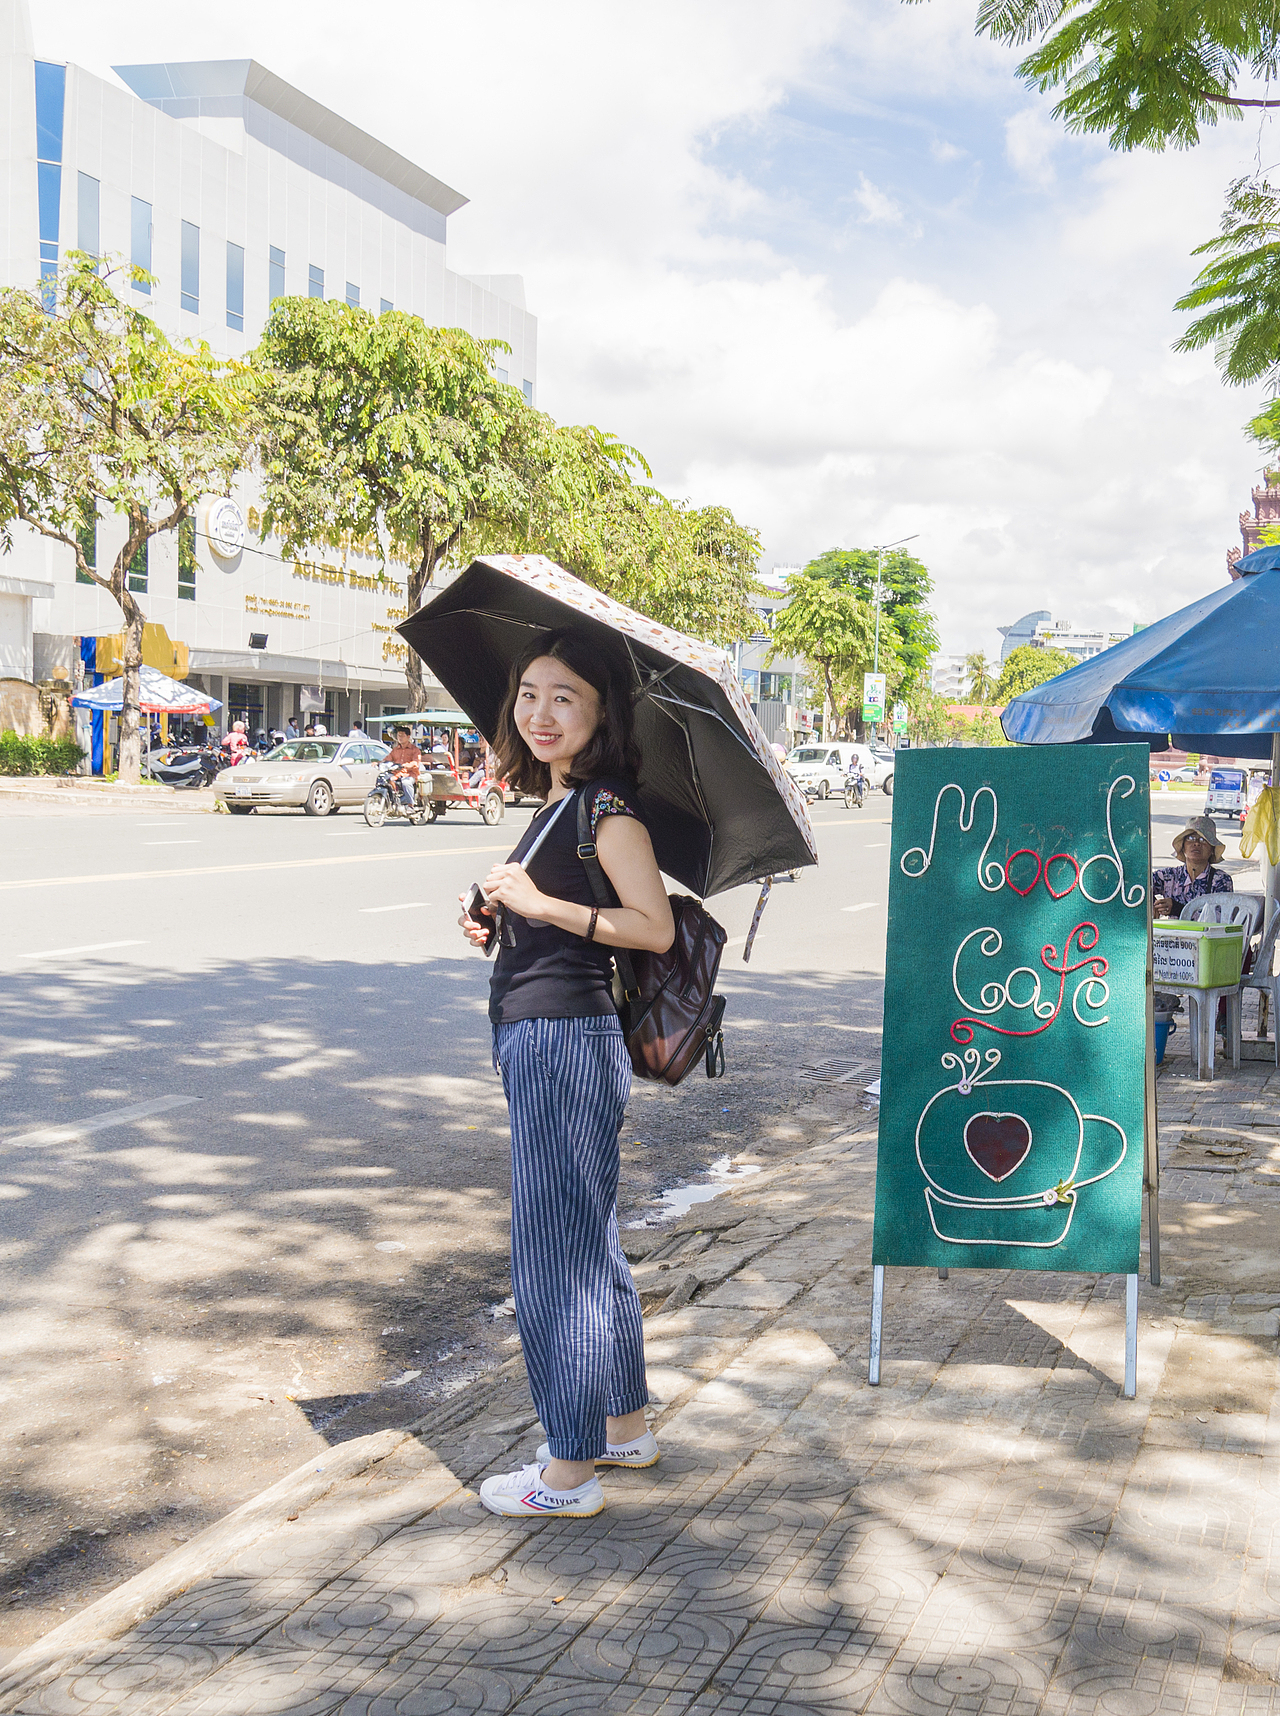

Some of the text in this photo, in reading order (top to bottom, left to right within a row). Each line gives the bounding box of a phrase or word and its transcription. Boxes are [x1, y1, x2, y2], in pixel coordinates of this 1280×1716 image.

[293, 558, 346, 584] ACLEDA
[349, 569, 379, 589] Bank
[900, 774, 1146, 908] Mood
[543, 1495, 581, 1506] FEIYUE
